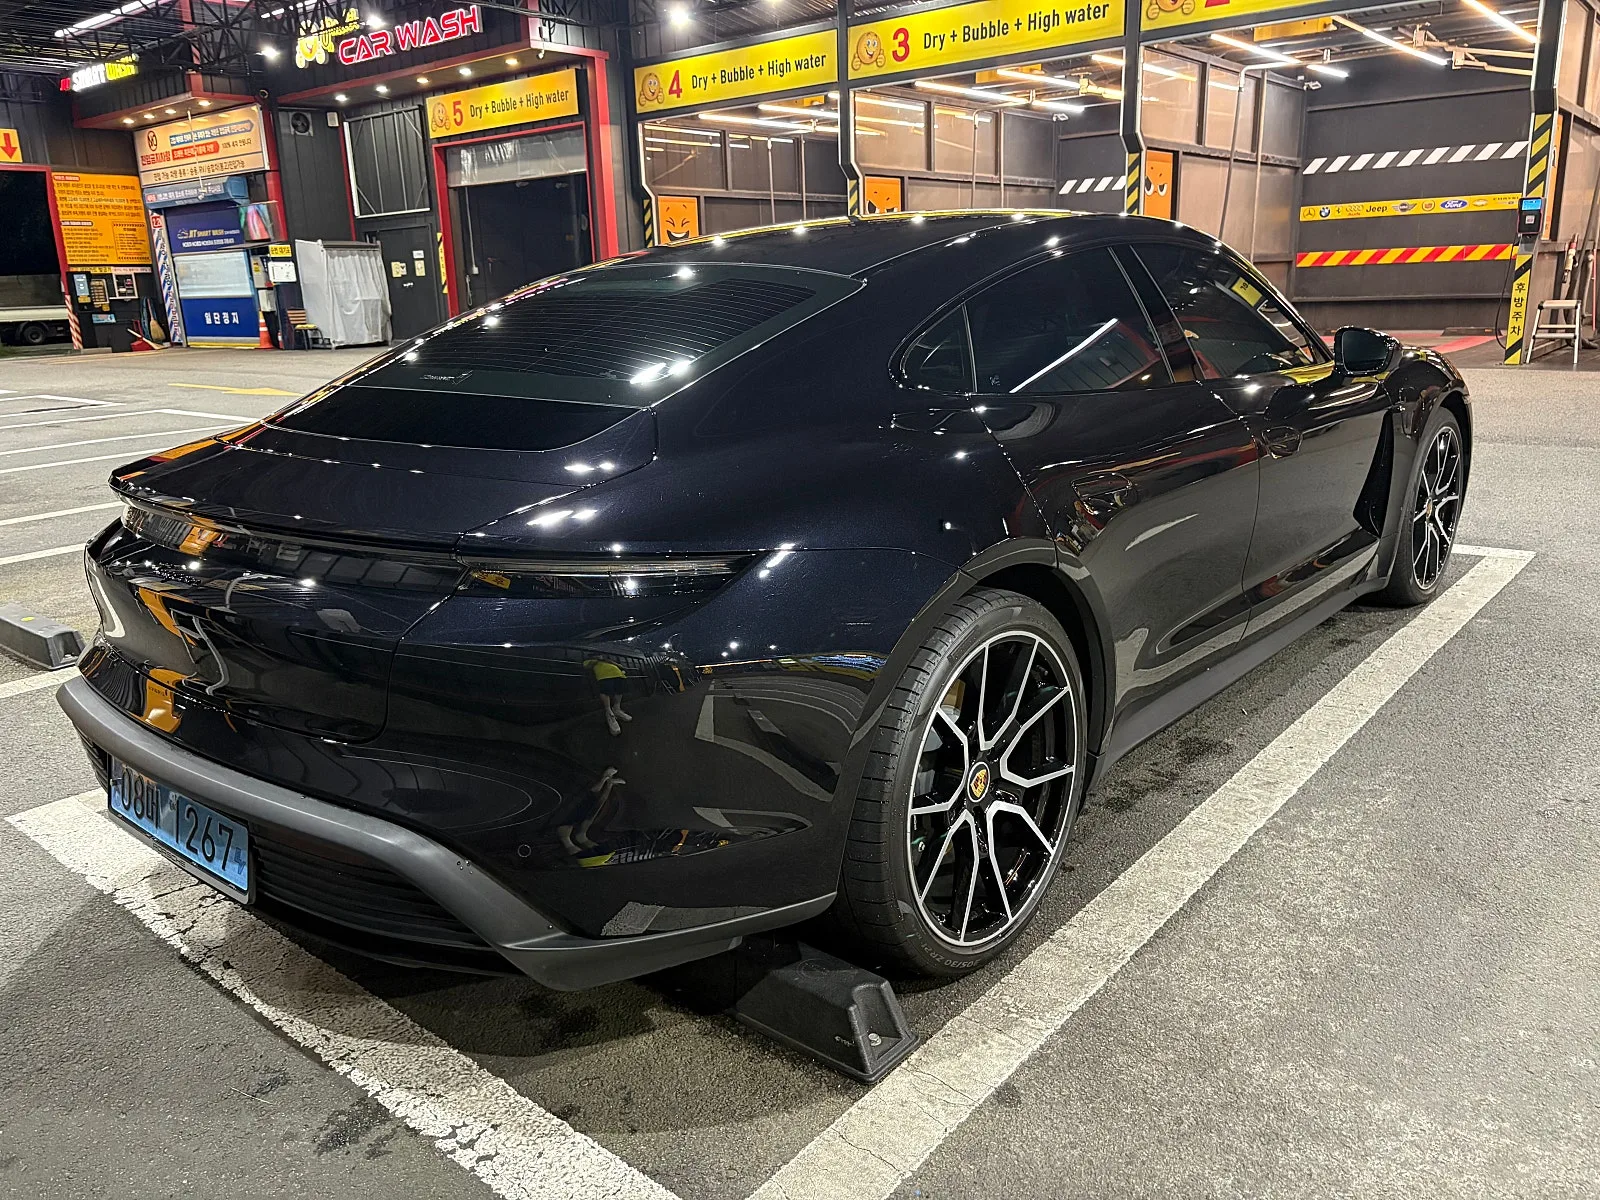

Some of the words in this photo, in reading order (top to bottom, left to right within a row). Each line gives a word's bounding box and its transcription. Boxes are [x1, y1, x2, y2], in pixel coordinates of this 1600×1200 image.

[339, 30, 393, 65] CAR
[395, 5, 479, 51] WASH
[892, 27, 910, 62] 3
[923, 33, 946, 51] Dry
[950, 32, 958, 43] +
[963, 19, 1009, 43] Bubble
[1014, 18, 1022, 31] +
[1028, 9, 1060, 33] High
[1065, 3, 1109, 25] water
[668, 69, 682, 98] 4
[692, 75, 708, 91] Dry
[711, 73, 717, 83] +
[720, 66, 754, 84] Bubble
[758, 64, 764, 75] +
[768, 57, 791, 78] High
[794, 54, 826, 70] water
[453, 100, 464, 127] 5
[470, 104, 483, 119] Dry
[491, 97, 517, 114] Bubble
[526, 92, 544, 110] High
[545, 90, 569, 104] water
[1366, 205, 1388, 213] Jeep
[204, 311, 239, 325] 일단정지
[1510, 282, 1526, 336] 후방주차
[174, 798, 234, 872] 1267
